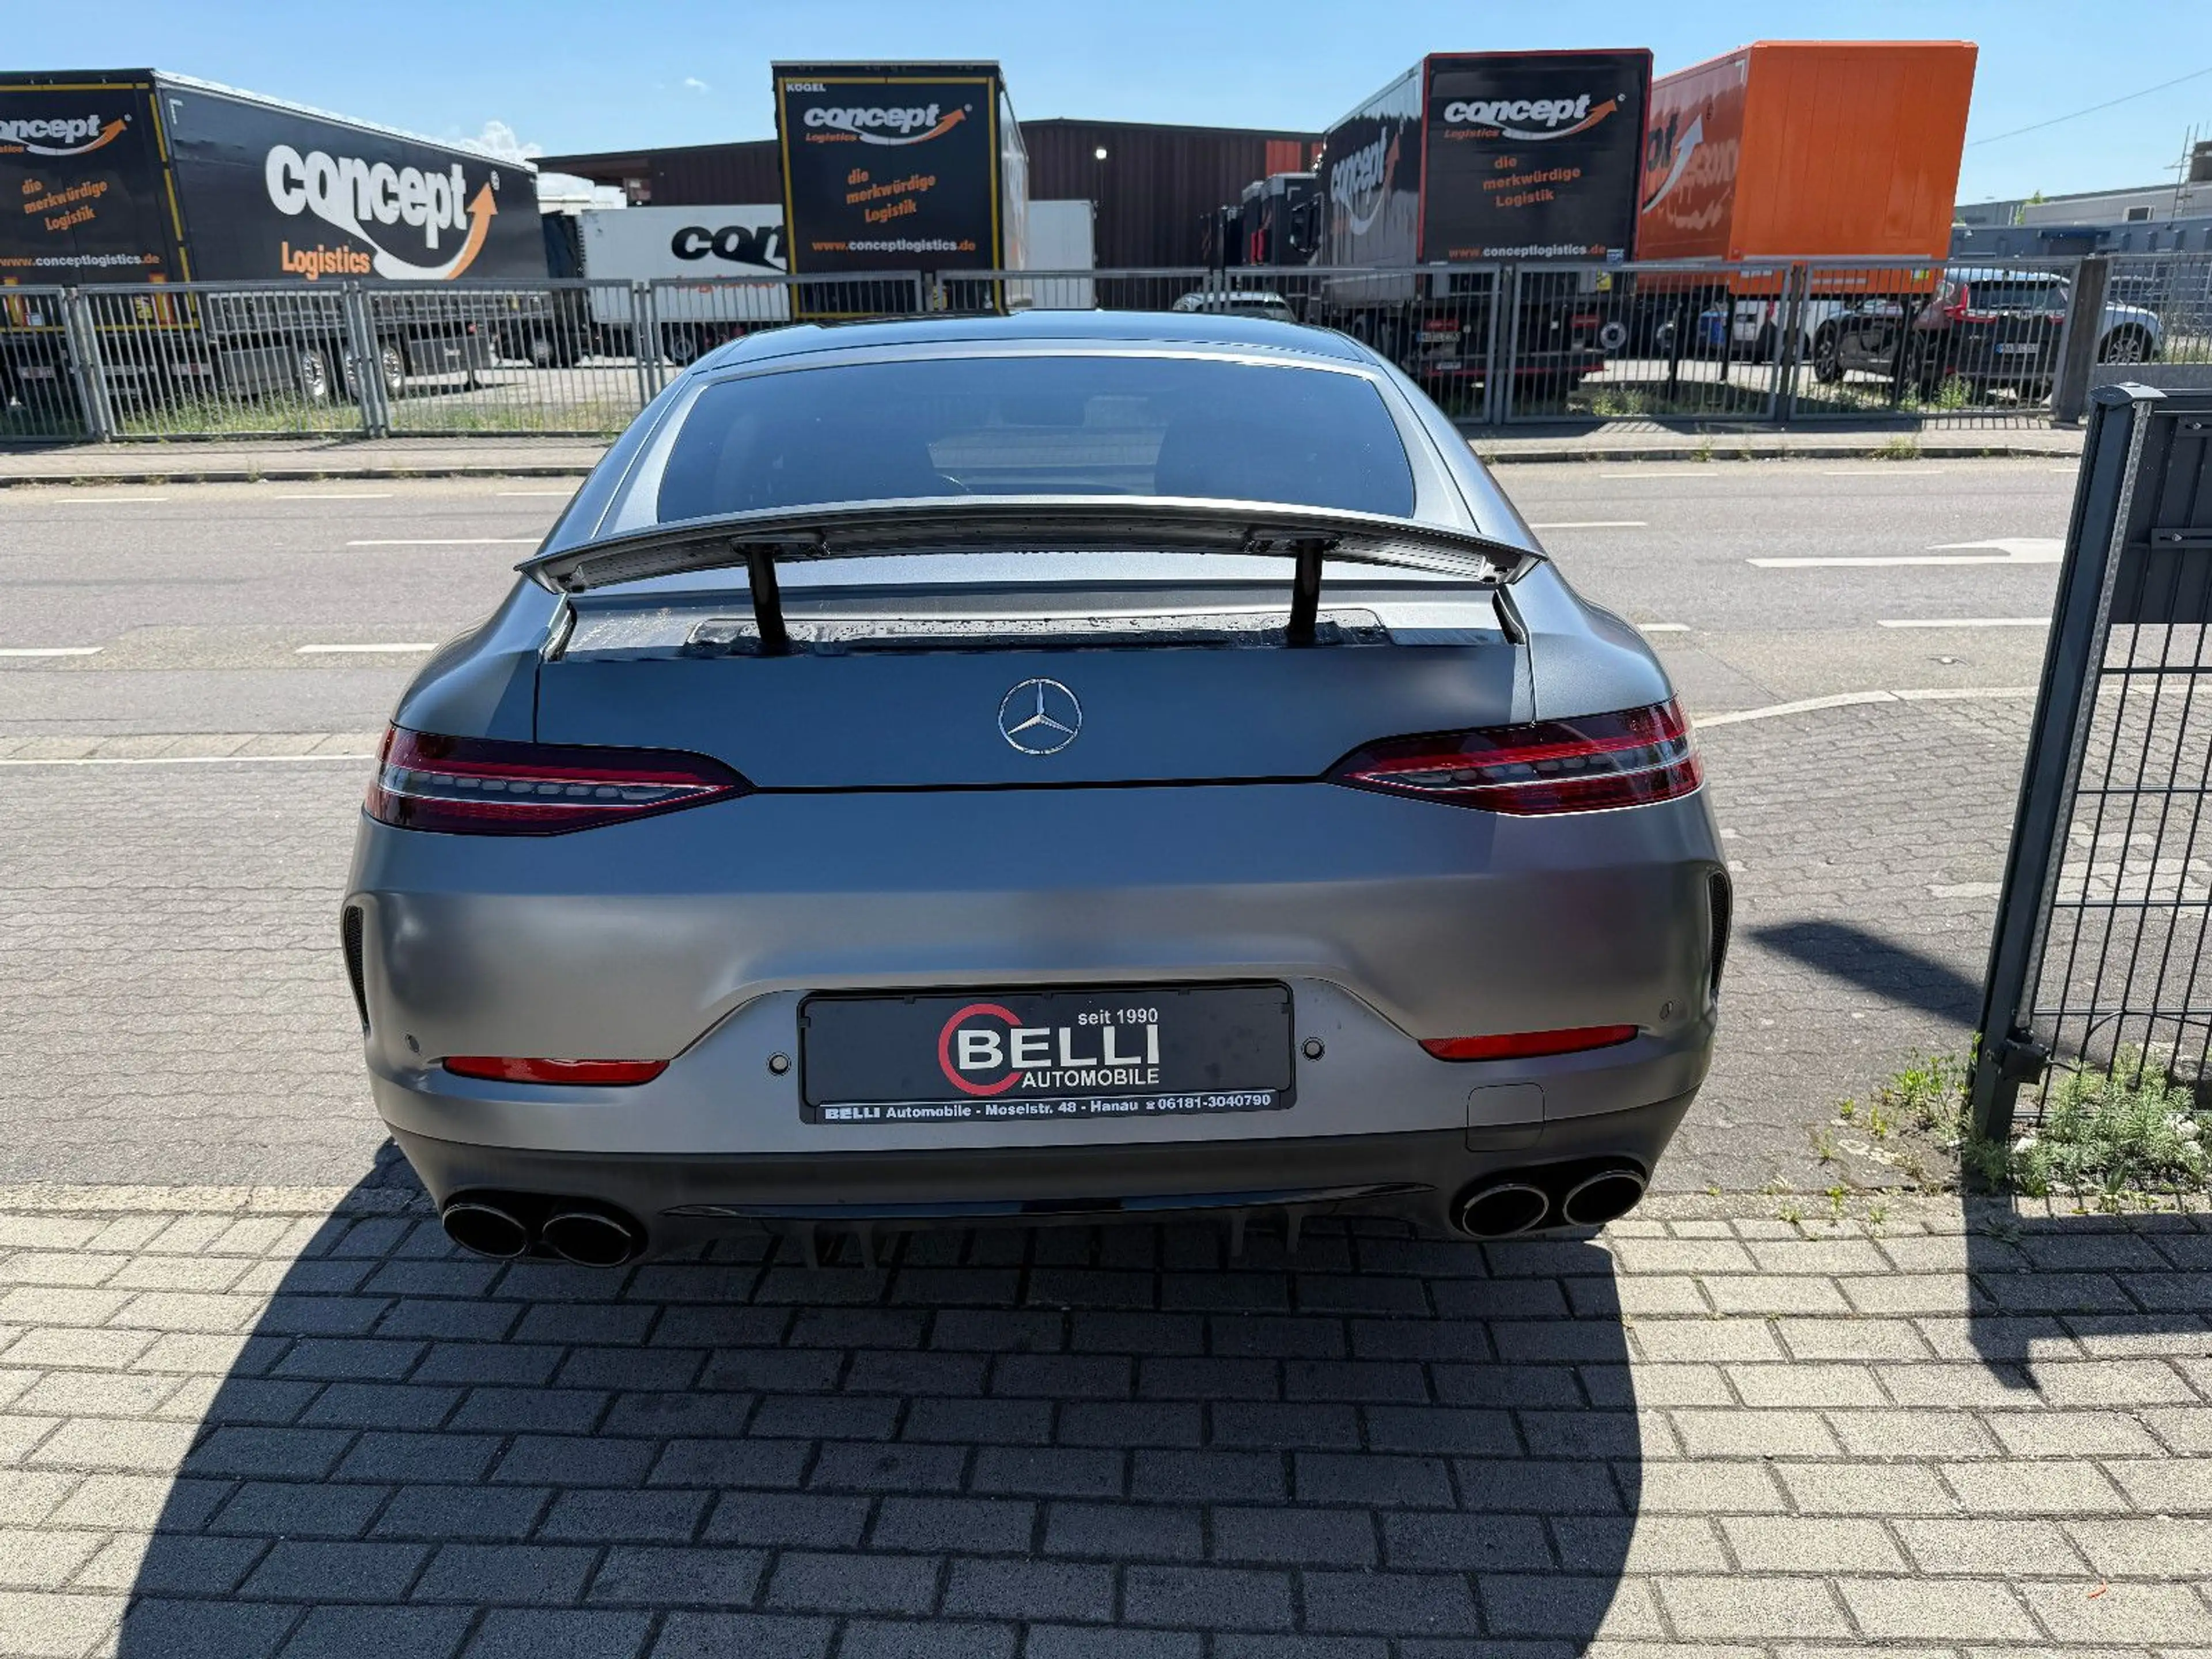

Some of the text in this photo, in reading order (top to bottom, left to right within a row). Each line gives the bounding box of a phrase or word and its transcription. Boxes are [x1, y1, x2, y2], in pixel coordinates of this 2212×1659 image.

[804, 104, 940, 134] concept
[1444, 94, 1591, 127] concept
[1494, 156, 1518, 169] die
[22, 179, 43, 195] die
[847, 168, 869, 185] die
[1483, 168, 1581, 191] merkwürdige
[24, 181, 108, 214] merkwürdige
[266, 145, 467, 249] concept
[846, 175, 937, 204] merkwürdige
[1495, 188, 1555, 208] Logistik
[44, 205, 96, 230] Logistik
[865, 199, 918, 224] Logistik
[812, 238, 976, 252] www.conceptlogistics.de
[1448, 244, 1606, 259] www.conceptlogistics.de
[282, 241, 371, 281] Logistics
[1078, 1008, 1158, 1025] seit 1990
[958, 1024, 1160, 1070] BELLI
[1021, 1069, 1160, 1088] AUTOMOBILE
[825, 1107, 880, 1119] BELLI
[886, 1104, 972, 1118] Automobile
[985, 1103, 1053, 1116] Moselstr.
[1058, 1102, 1077, 1113] 48
[1090, 1101, 1138, 1113] Hanau
